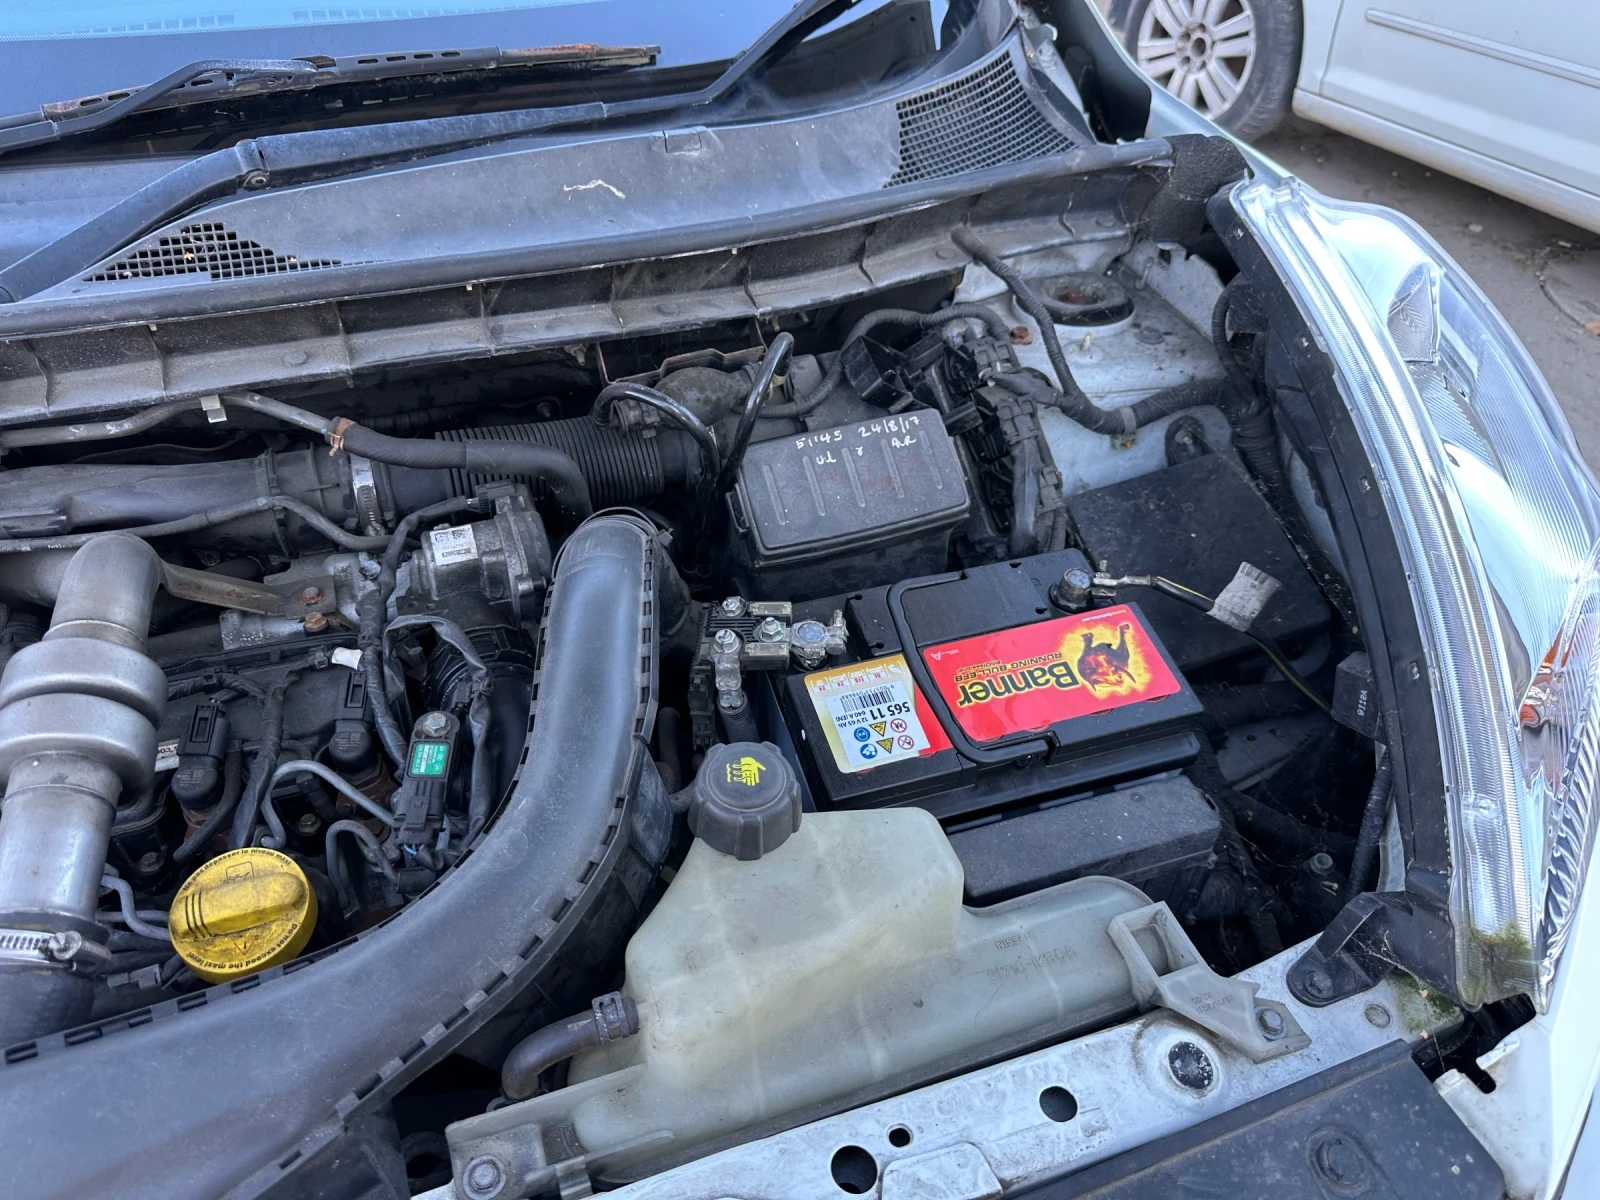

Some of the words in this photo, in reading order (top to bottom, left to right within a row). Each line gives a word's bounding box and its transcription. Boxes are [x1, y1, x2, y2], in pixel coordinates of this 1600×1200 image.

[1010, 652, 1063, 669] RUNNING
[954, 671, 977, 682] EFB
[978, 664, 1008, 676] BULL
[958, 660, 1080, 706] Banner
[870, 707, 886, 720] 11
[887, 701, 911, 717] 565
[835, 714, 848, 722] (EN)
[182, 881, 193, 891] Ne
[191, 869, 205, 882] pas
[250, 847, 275, 857] niveau
[275, 853, 292, 866] maxi
[288, 923, 298, 934] Do
[275, 934, 288, 948] not
[187, 951, 204, 965] level
[245, 946, 276, 967] exceed
[205, 961, 226, 969] maxi
